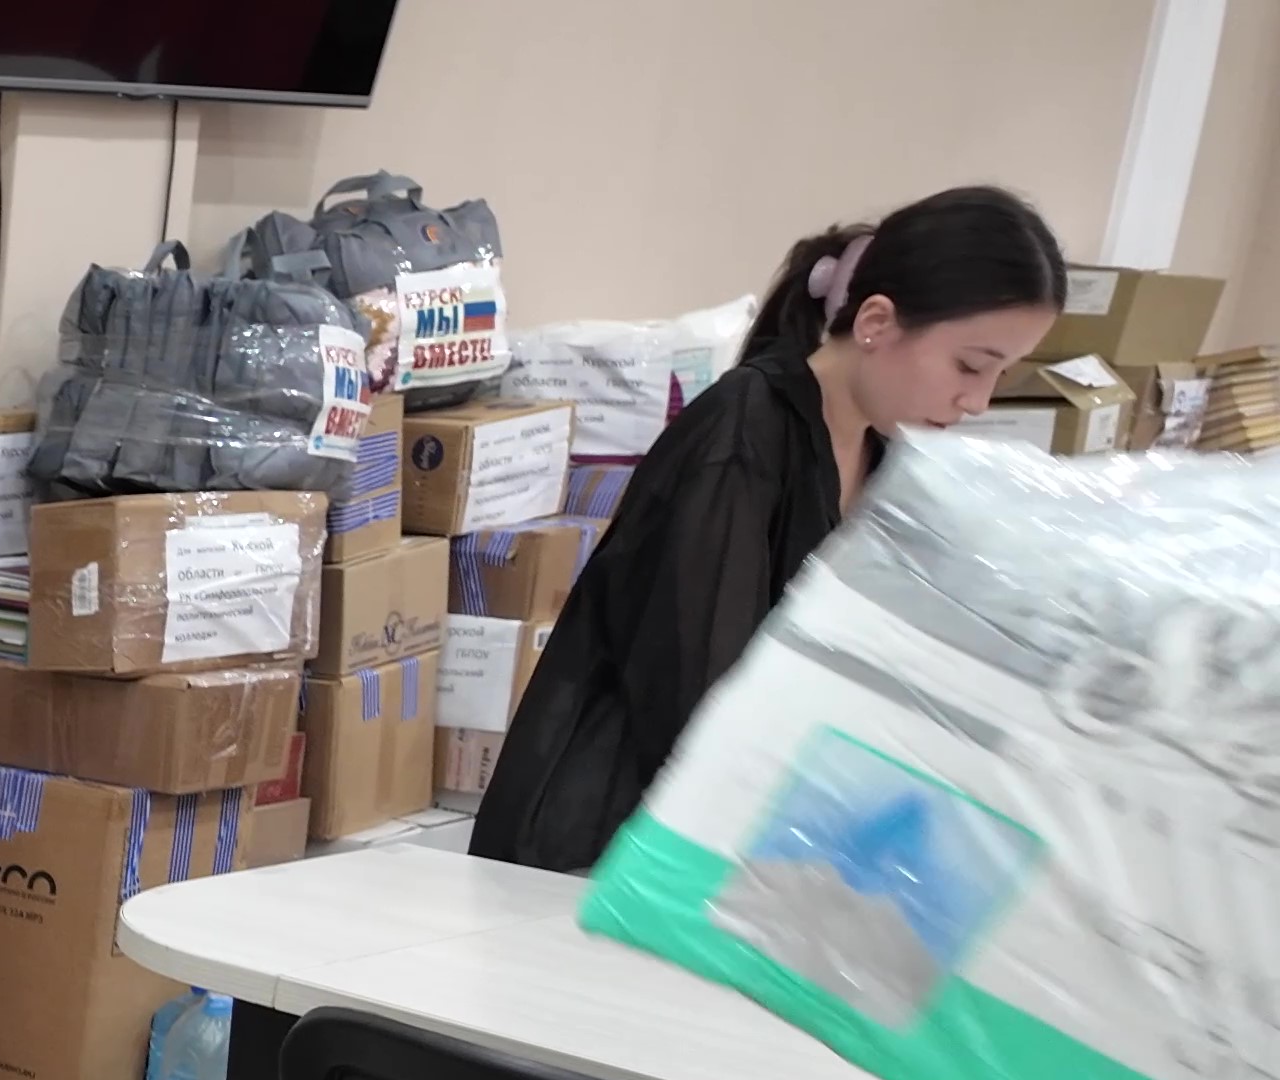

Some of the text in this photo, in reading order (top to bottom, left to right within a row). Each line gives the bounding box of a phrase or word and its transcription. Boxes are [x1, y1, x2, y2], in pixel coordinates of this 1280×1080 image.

[416, 305, 459, 339] МЫ
[412, 338, 495, 369] ВМЕСТЕ!
[334, 366, 359, 401] МЫ
[178, 566, 225, 581] области
